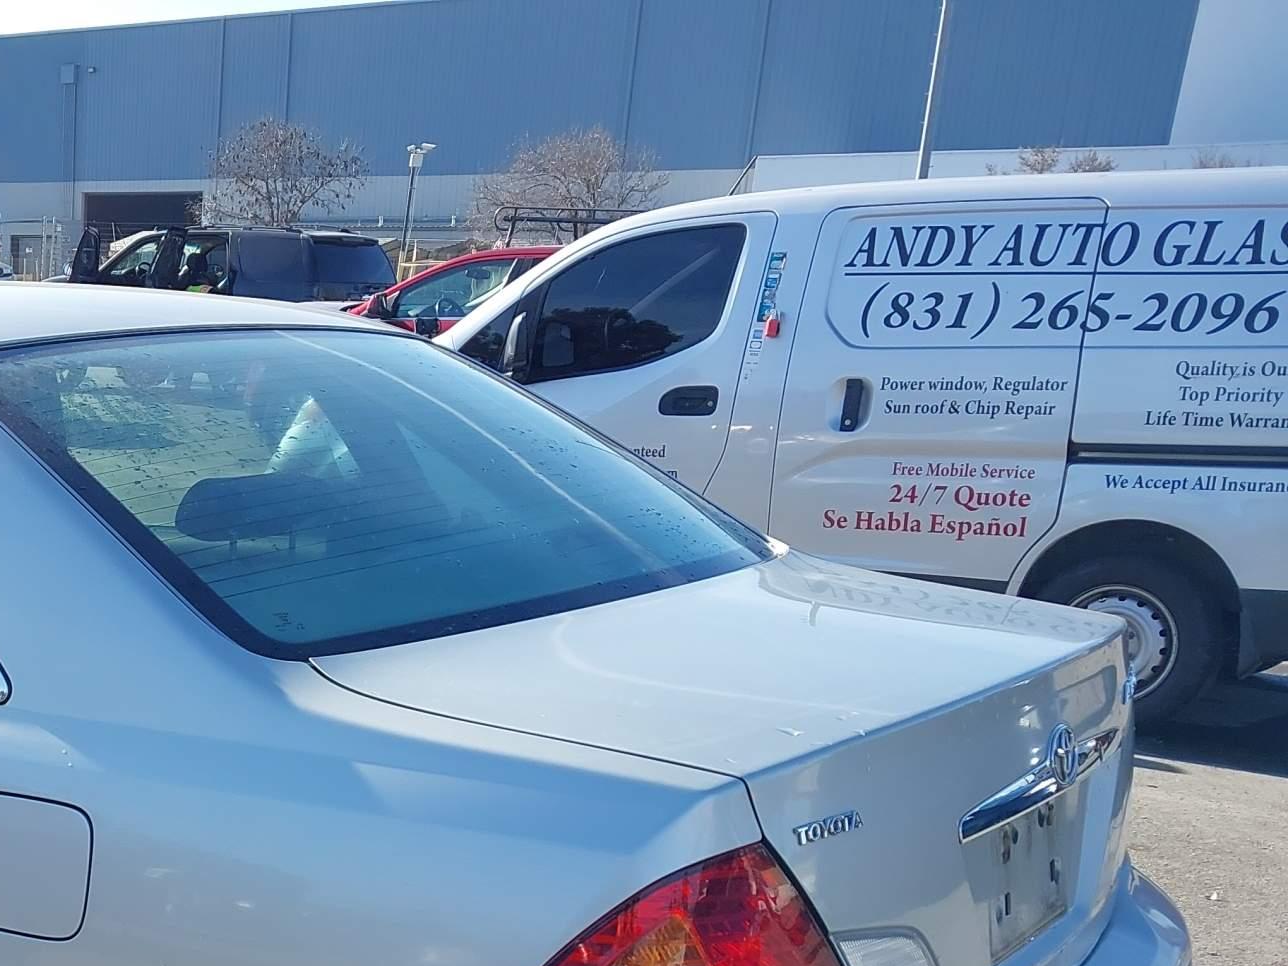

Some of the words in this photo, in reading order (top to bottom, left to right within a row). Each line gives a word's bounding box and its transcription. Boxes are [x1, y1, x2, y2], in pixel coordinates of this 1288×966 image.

[844, 225, 995, 267] ANDY
[987, 221, 1140, 267] AUTO
[861, 282, 1000, 340] (831)
[1012, 290, 1287, 335] 265-2096
[1175, 360, 1239, 381] Quality
[1242, 361, 1256, 377] is
[880, 376, 925, 391] Power
[928, 375, 988, 393] window,
[992, 375, 1068, 396] Regulator
[1178, 386, 1210, 406] Top
[1214, 386, 1284, 407] Priority
[884, 400, 911, 415] Sun
[914, 400, 948, 415] roof
[948, 401, 961, 415] &
[964, 401, 1001, 420] Chip
[1004, 401, 1056, 420] Repair
[1144, 410, 1177, 426] Life
[1181, 411, 1224, 427] Time
[892, 462, 923, 476] Free
[926, 463, 977, 478] Mobile
[980, 464, 1036, 479] Service
[1104, 474, 1129, 489] We
[1131, 475, 1189, 495] Accept
[1191, 475, 1217, 491] All
[1220, 476, 1288, 493] Insuran
[889, 483, 948, 507] 24/7
[954, 485, 1032, 512] Quote
[822, 509, 848, 529] Se
[853, 511, 922, 533] Habla
[927, 514, 1027, 541] Español
[793, 809, 864, 846] TOYOTA
